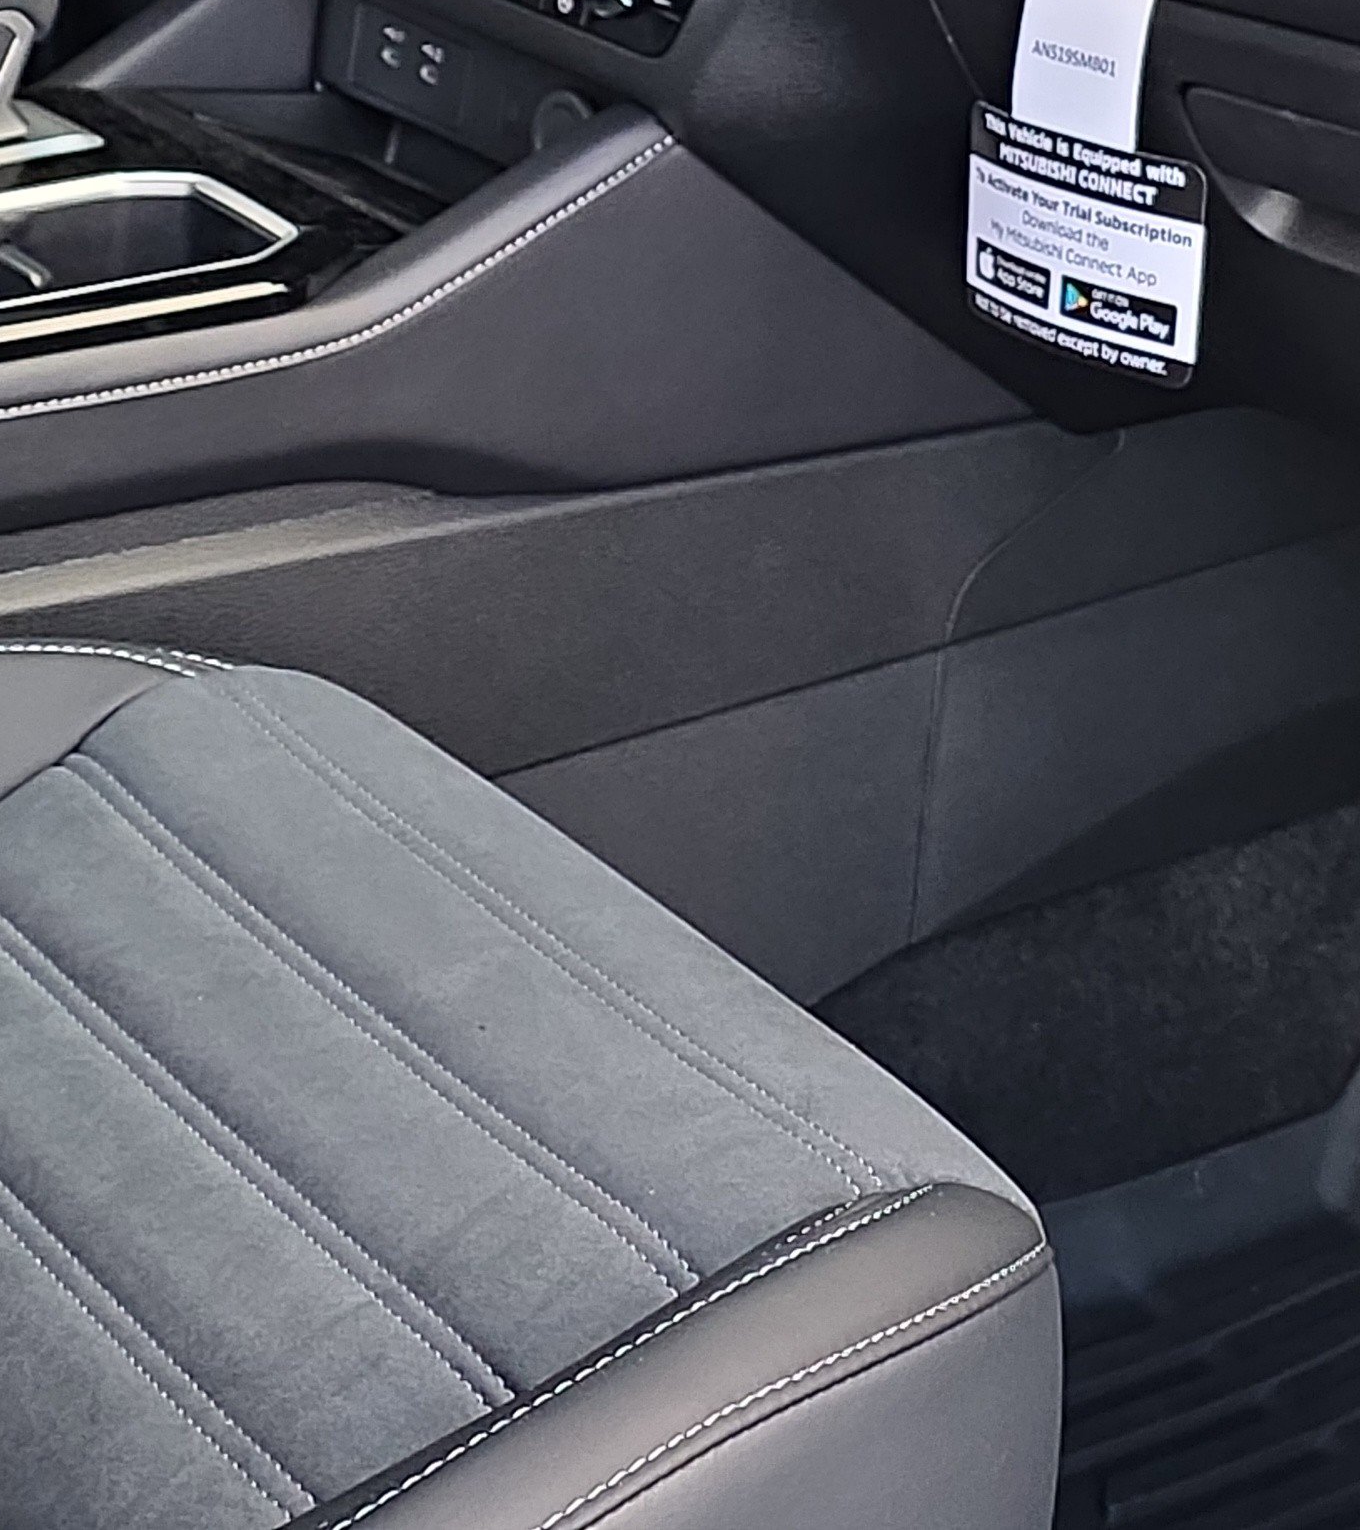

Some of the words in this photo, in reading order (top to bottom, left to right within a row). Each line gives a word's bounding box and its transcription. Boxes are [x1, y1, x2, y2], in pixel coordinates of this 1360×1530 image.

[999, 142, 1077, 184] MITSUBISHI
[1078, 169, 1158, 205] CONNECT
[1008, 122, 1053, 152] Vehicle
[1056, 137, 1069, 157] is
[1073, 143, 1142, 177] Equipped
[1146, 165, 1186, 187] with
[988, 174, 1028, 202] Activate
[1031, 190, 1059, 212] Your
[1062, 201, 1092, 222] Trial
[1095, 211, 1193, 247] Subscription
[1021, 210, 1083, 244] Download
[1085, 232, 1110, 252] the
[1006, 226, 1064, 260] Mitsubishi
[1065, 248, 1123, 277] Connect
[1126, 267, 1158, 288] App
[1057, 333, 1101, 358] except
[1101, 344, 1120, 365] by
[1090, 302, 1139, 331] Google
[1140, 313, 1171, 340] Play
